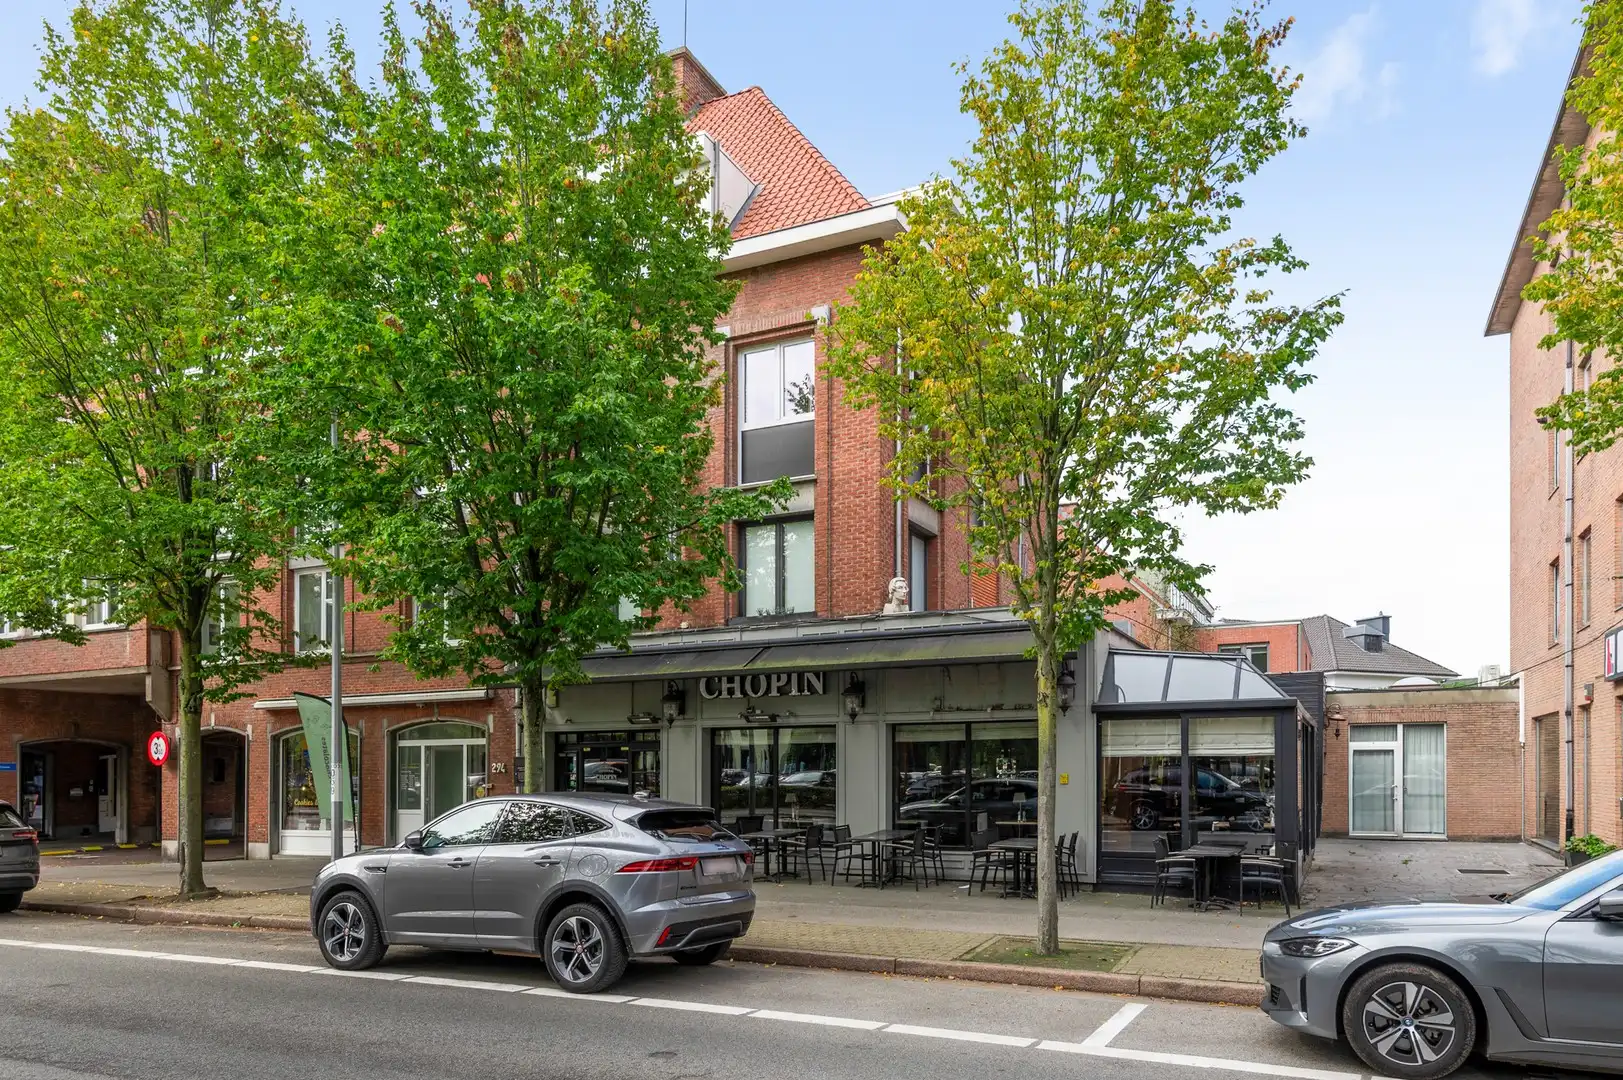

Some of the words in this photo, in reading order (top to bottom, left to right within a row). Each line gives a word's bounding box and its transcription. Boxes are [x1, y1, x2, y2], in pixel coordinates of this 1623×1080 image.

[699, 672, 824, 699] CHOPIN
[491, 763, 505, 773] 294
[293, 798, 313, 806] Cookies
